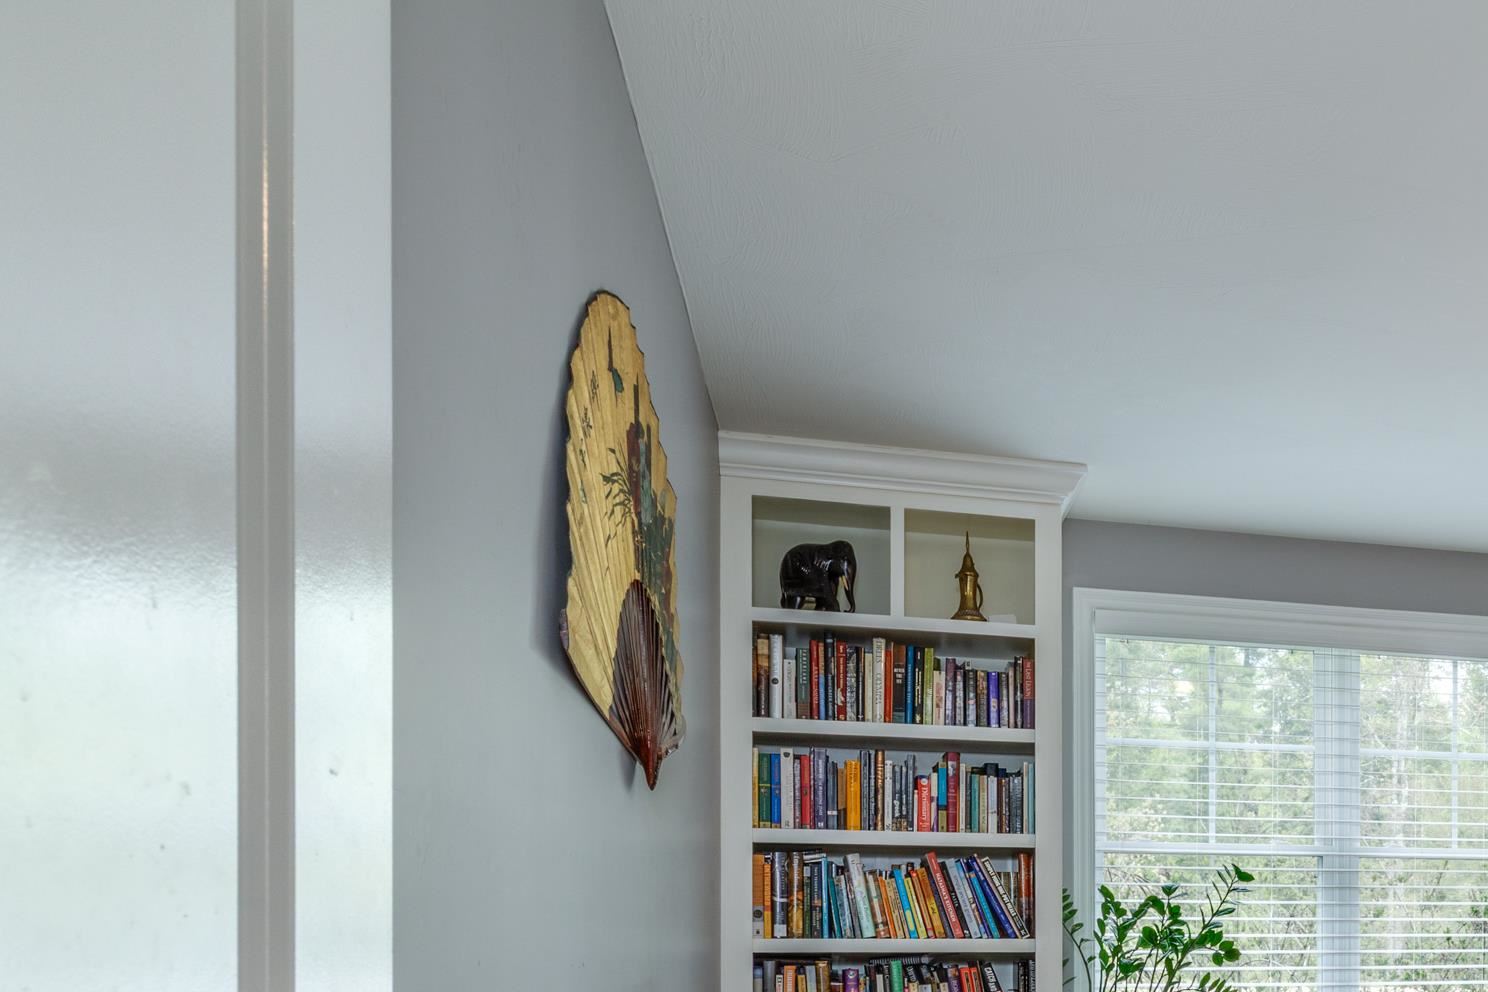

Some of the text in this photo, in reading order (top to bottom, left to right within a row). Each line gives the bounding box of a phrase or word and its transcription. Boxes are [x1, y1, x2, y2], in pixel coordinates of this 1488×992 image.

[920, 787, 928, 821] Dictionary
[984, 861, 995, 877] SIMPLY
[936, 873, 955, 921] NATASHA'S KITCHEN
[984, 967, 996, 982] CATCH
[989, 982, 997, 991] AND
